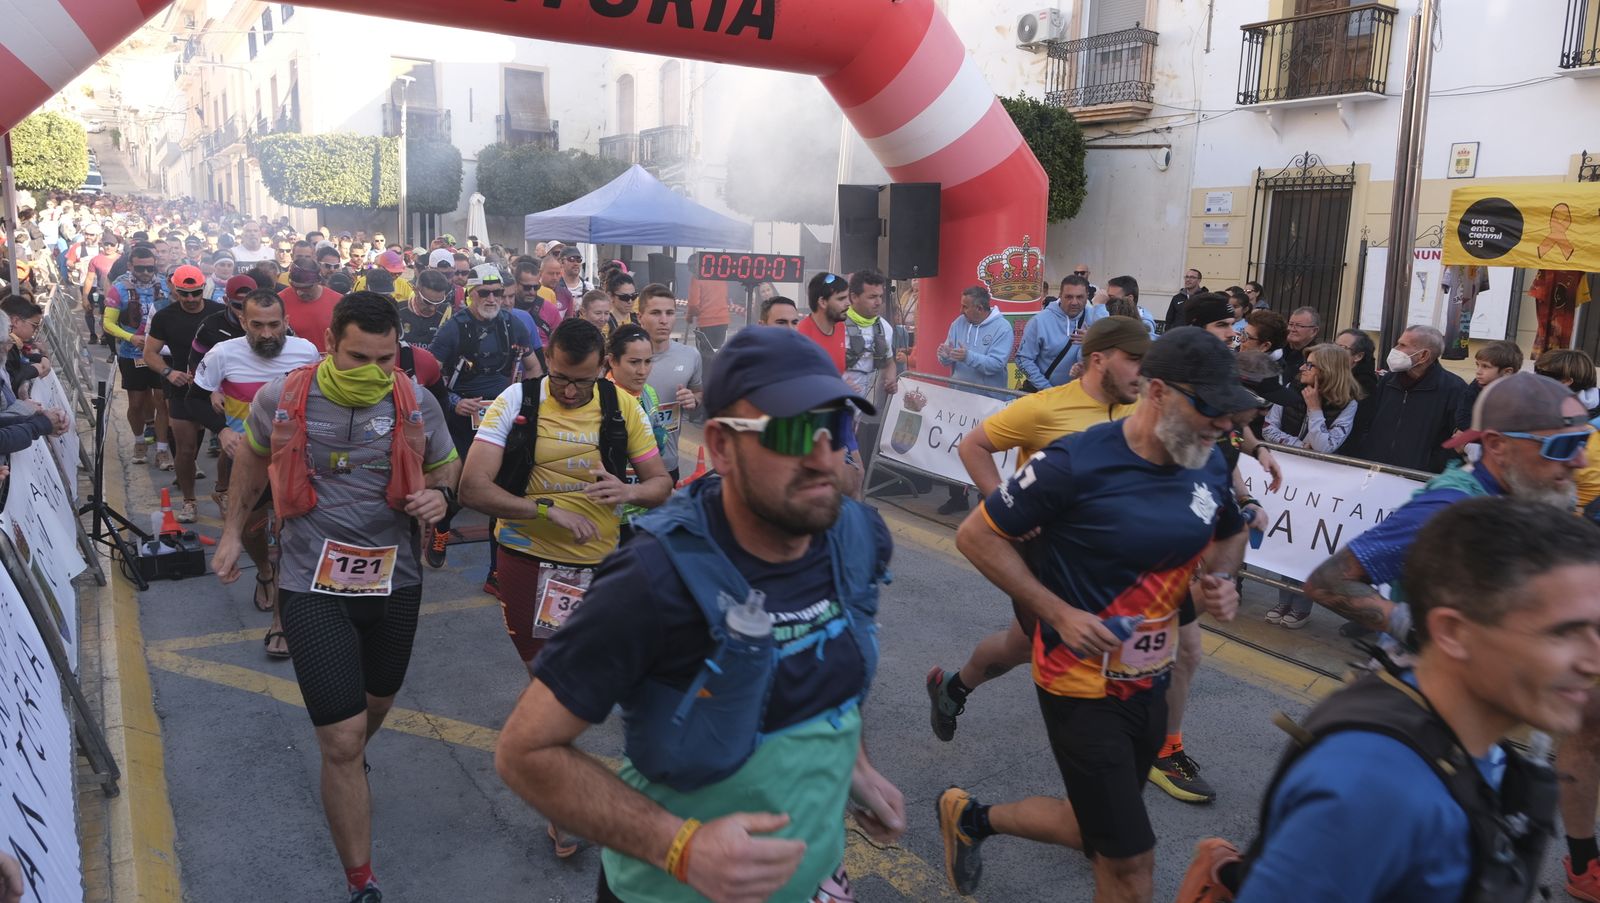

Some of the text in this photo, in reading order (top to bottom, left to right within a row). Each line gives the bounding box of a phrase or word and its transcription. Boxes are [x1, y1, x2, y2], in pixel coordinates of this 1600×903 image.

[1468, 232, 1503, 240] cienmil
[1470, 225, 1496, 233] entre
[1466, 239, 1484, 248] .org
[701, 254, 801, 280] 00:00:07
[1244, 476, 1394, 524] AYUNTAM
[335, 556, 382, 574] 121
[1133, 631, 1167, 653] 49
